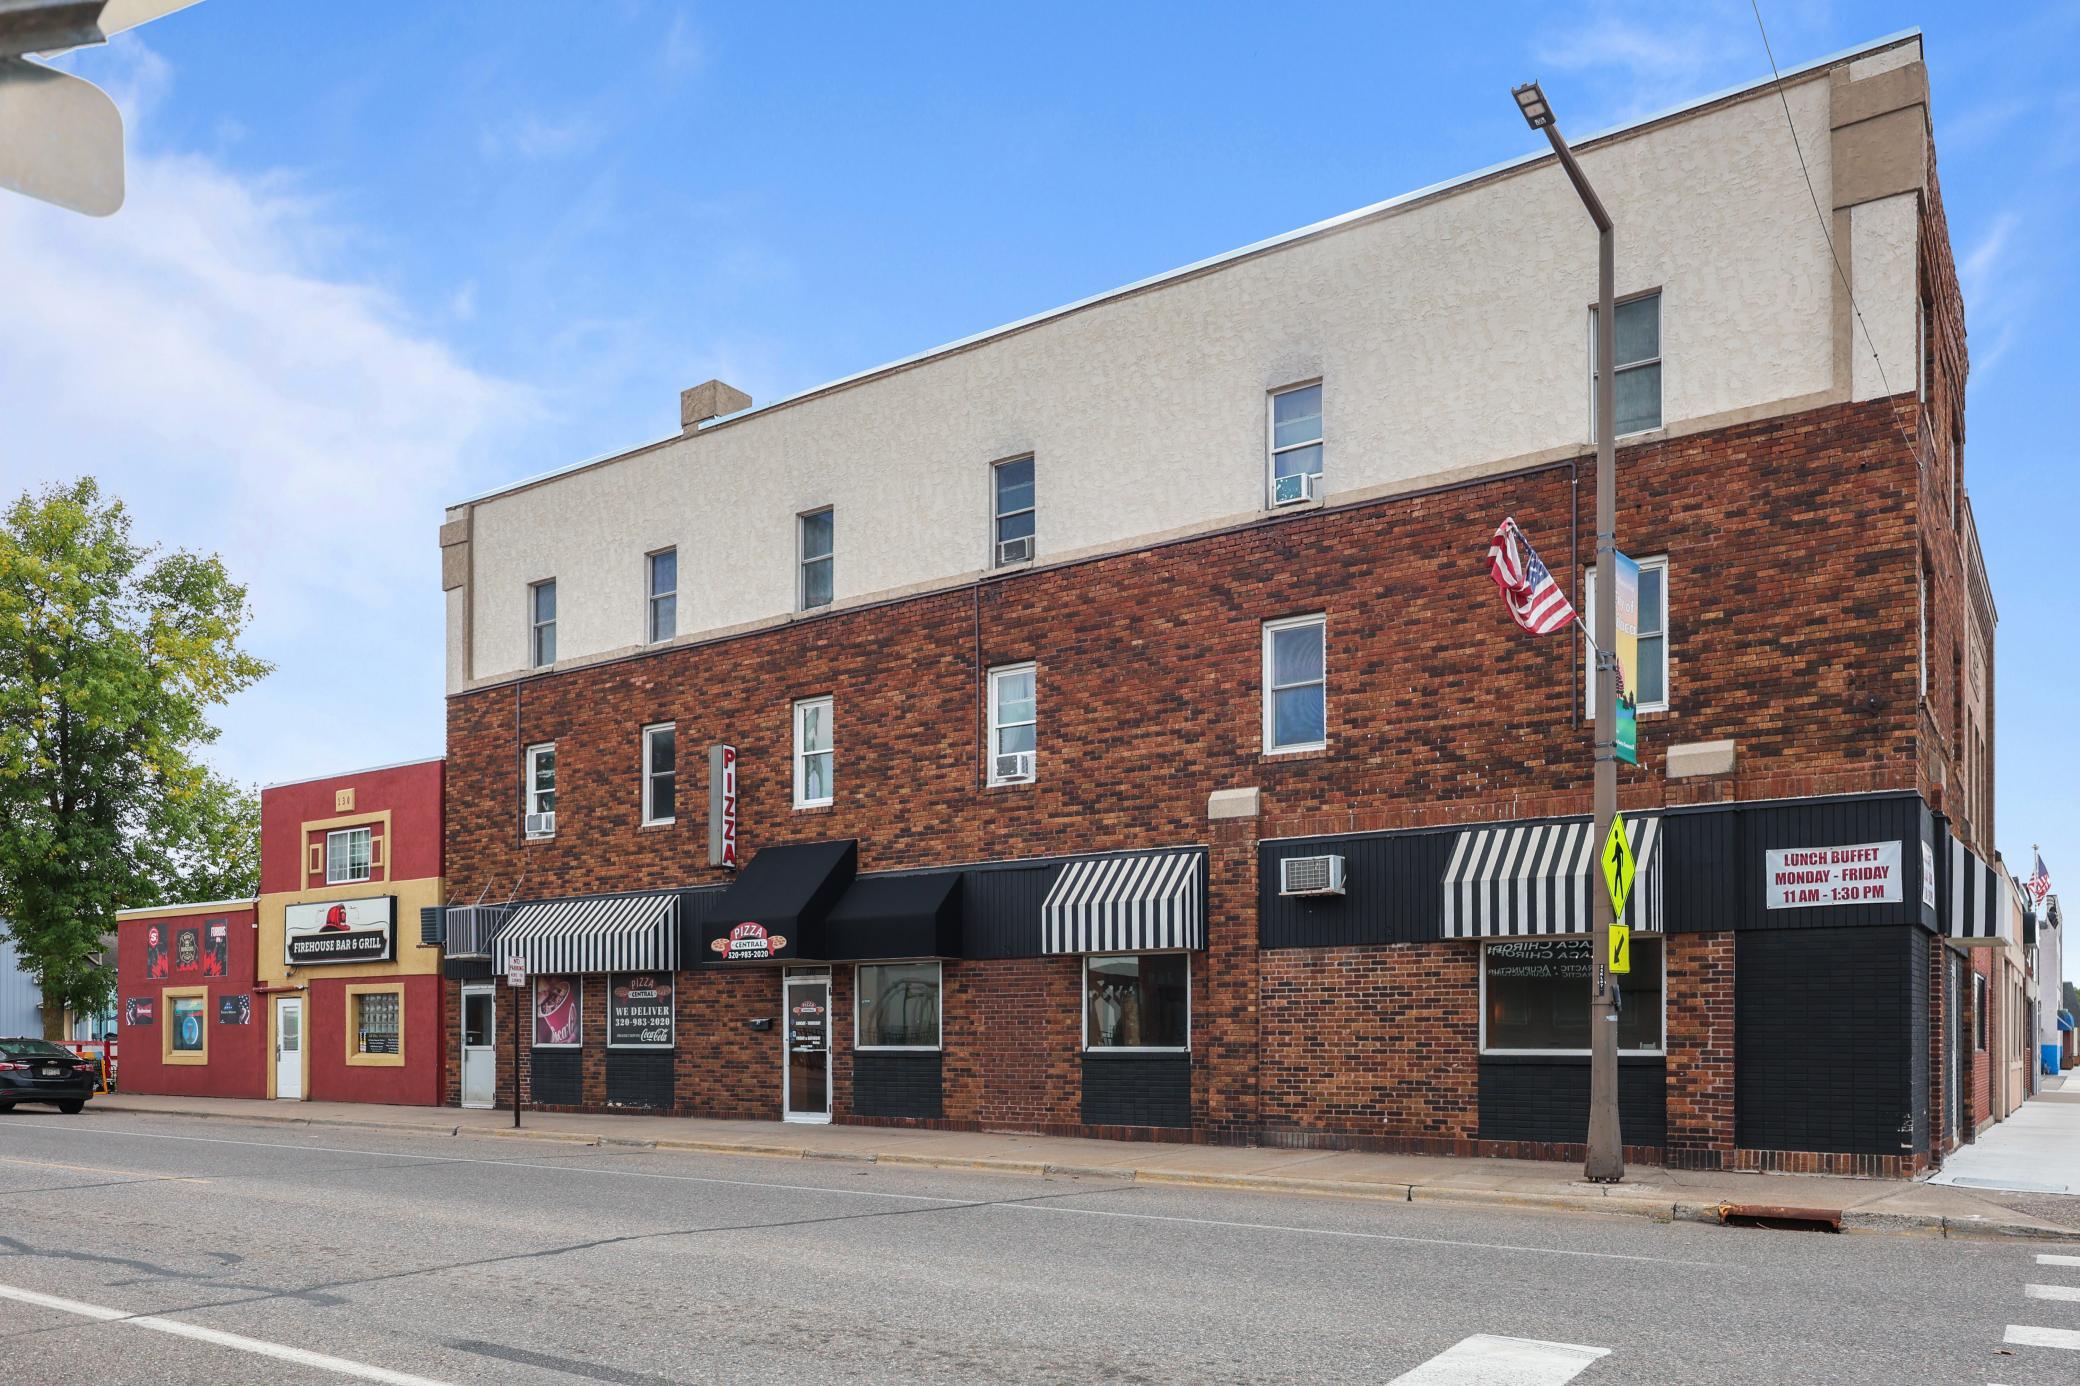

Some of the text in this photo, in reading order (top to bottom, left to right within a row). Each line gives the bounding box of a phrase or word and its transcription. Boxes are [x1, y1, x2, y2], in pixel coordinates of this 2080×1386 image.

[723, 748, 736, 865] PIZZA
[1784, 847, 1880, 867] LUNCH BUFFET
[1775, 869, 1831, 885] MONDAY
[1842, 865, 1890, 882] FRIDAY
[1783, 890, 1796, 903] 11
[1799, 888, 1820, 902] AM
[1830, 886, 1860, 901] 1:30
[1863, 884, 1885, 899] PM
[734, 925, 763, 939] PIZZA
[293, 937, 381, 953] FIREHOUSE BAR & GRILL
[728, 950, 769, 959] 320-983-2020
[631, 977, 654, 990] PIZZA
[615, 1006, 670, 1016] WE DELIVER
[615, 1017, 670, 1026] 320-983-2020
